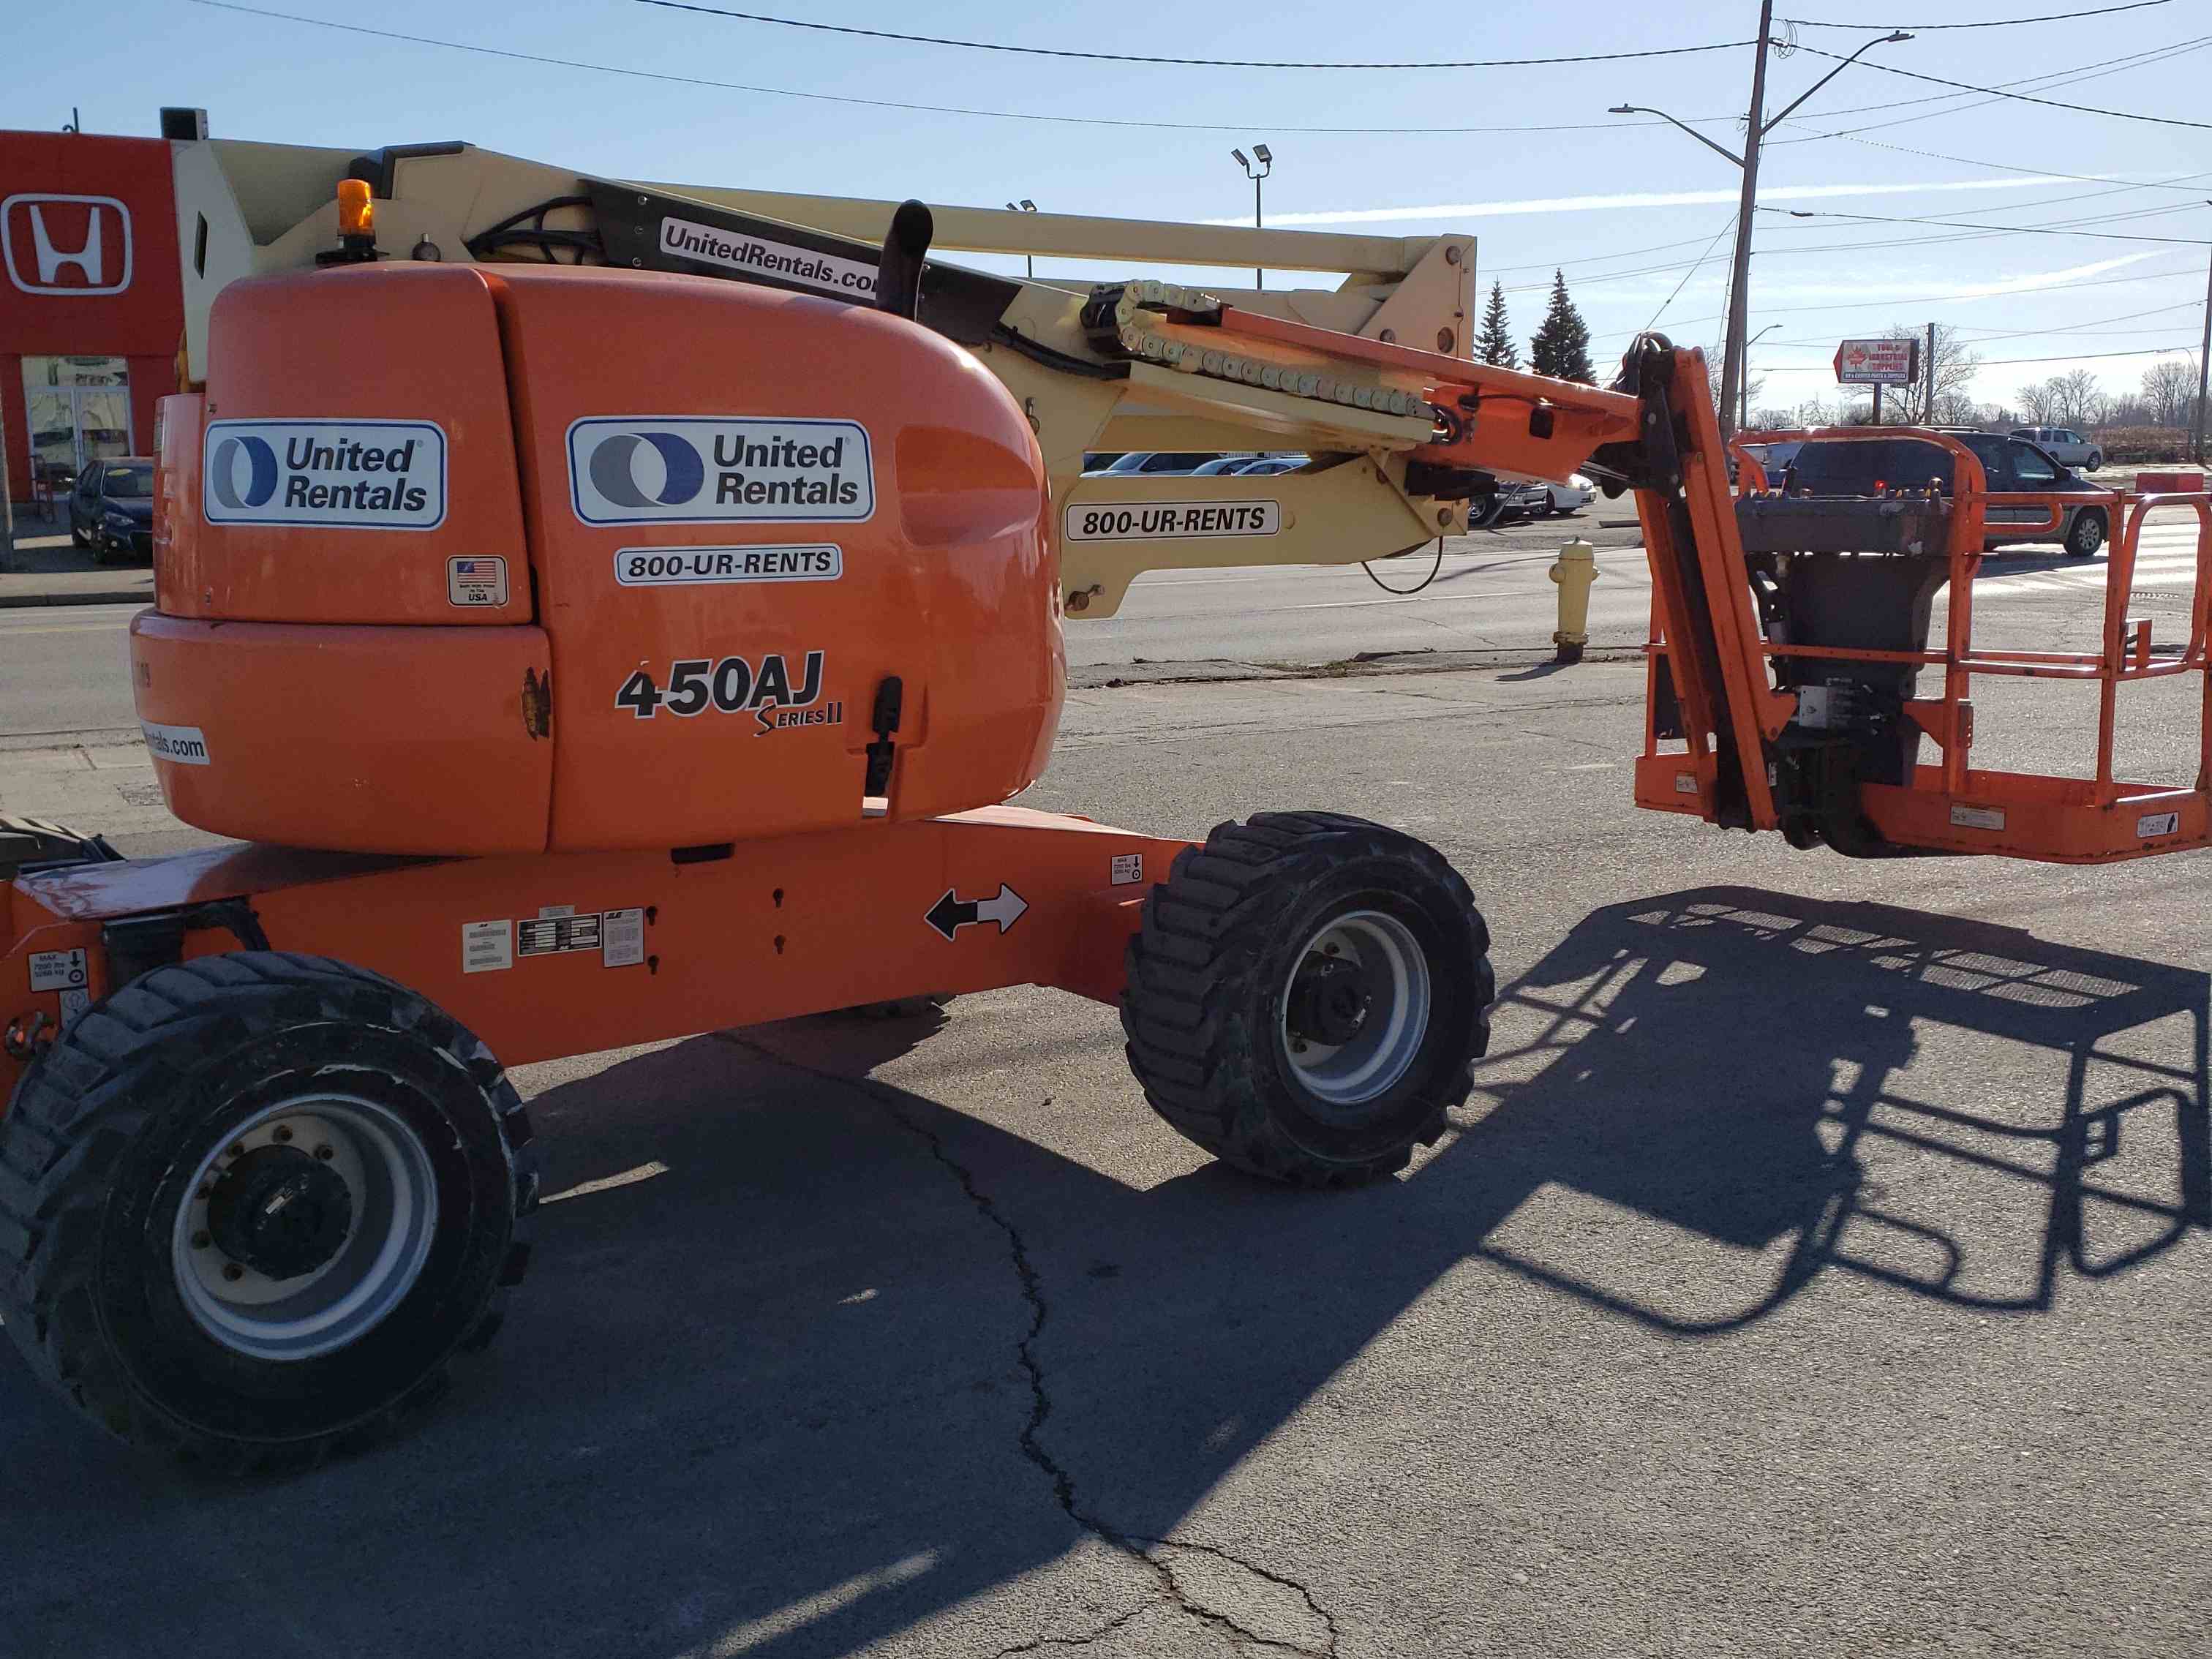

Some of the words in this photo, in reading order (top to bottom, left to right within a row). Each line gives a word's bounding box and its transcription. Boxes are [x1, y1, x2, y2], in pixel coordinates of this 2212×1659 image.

[286, 437, 415, 472] United
[714, 434, 843, 467] United
[285, 475, 426, 511] Rentals
[715, 472, 858, 504] Rentals
[1083, 507, 1265, 535] 800-UR-RENTS
[628, 552, 831, 577] 800-UR-RENTS
[469, 593, 487, 601] USA
[615, 650, 824, 719] 450AJ
